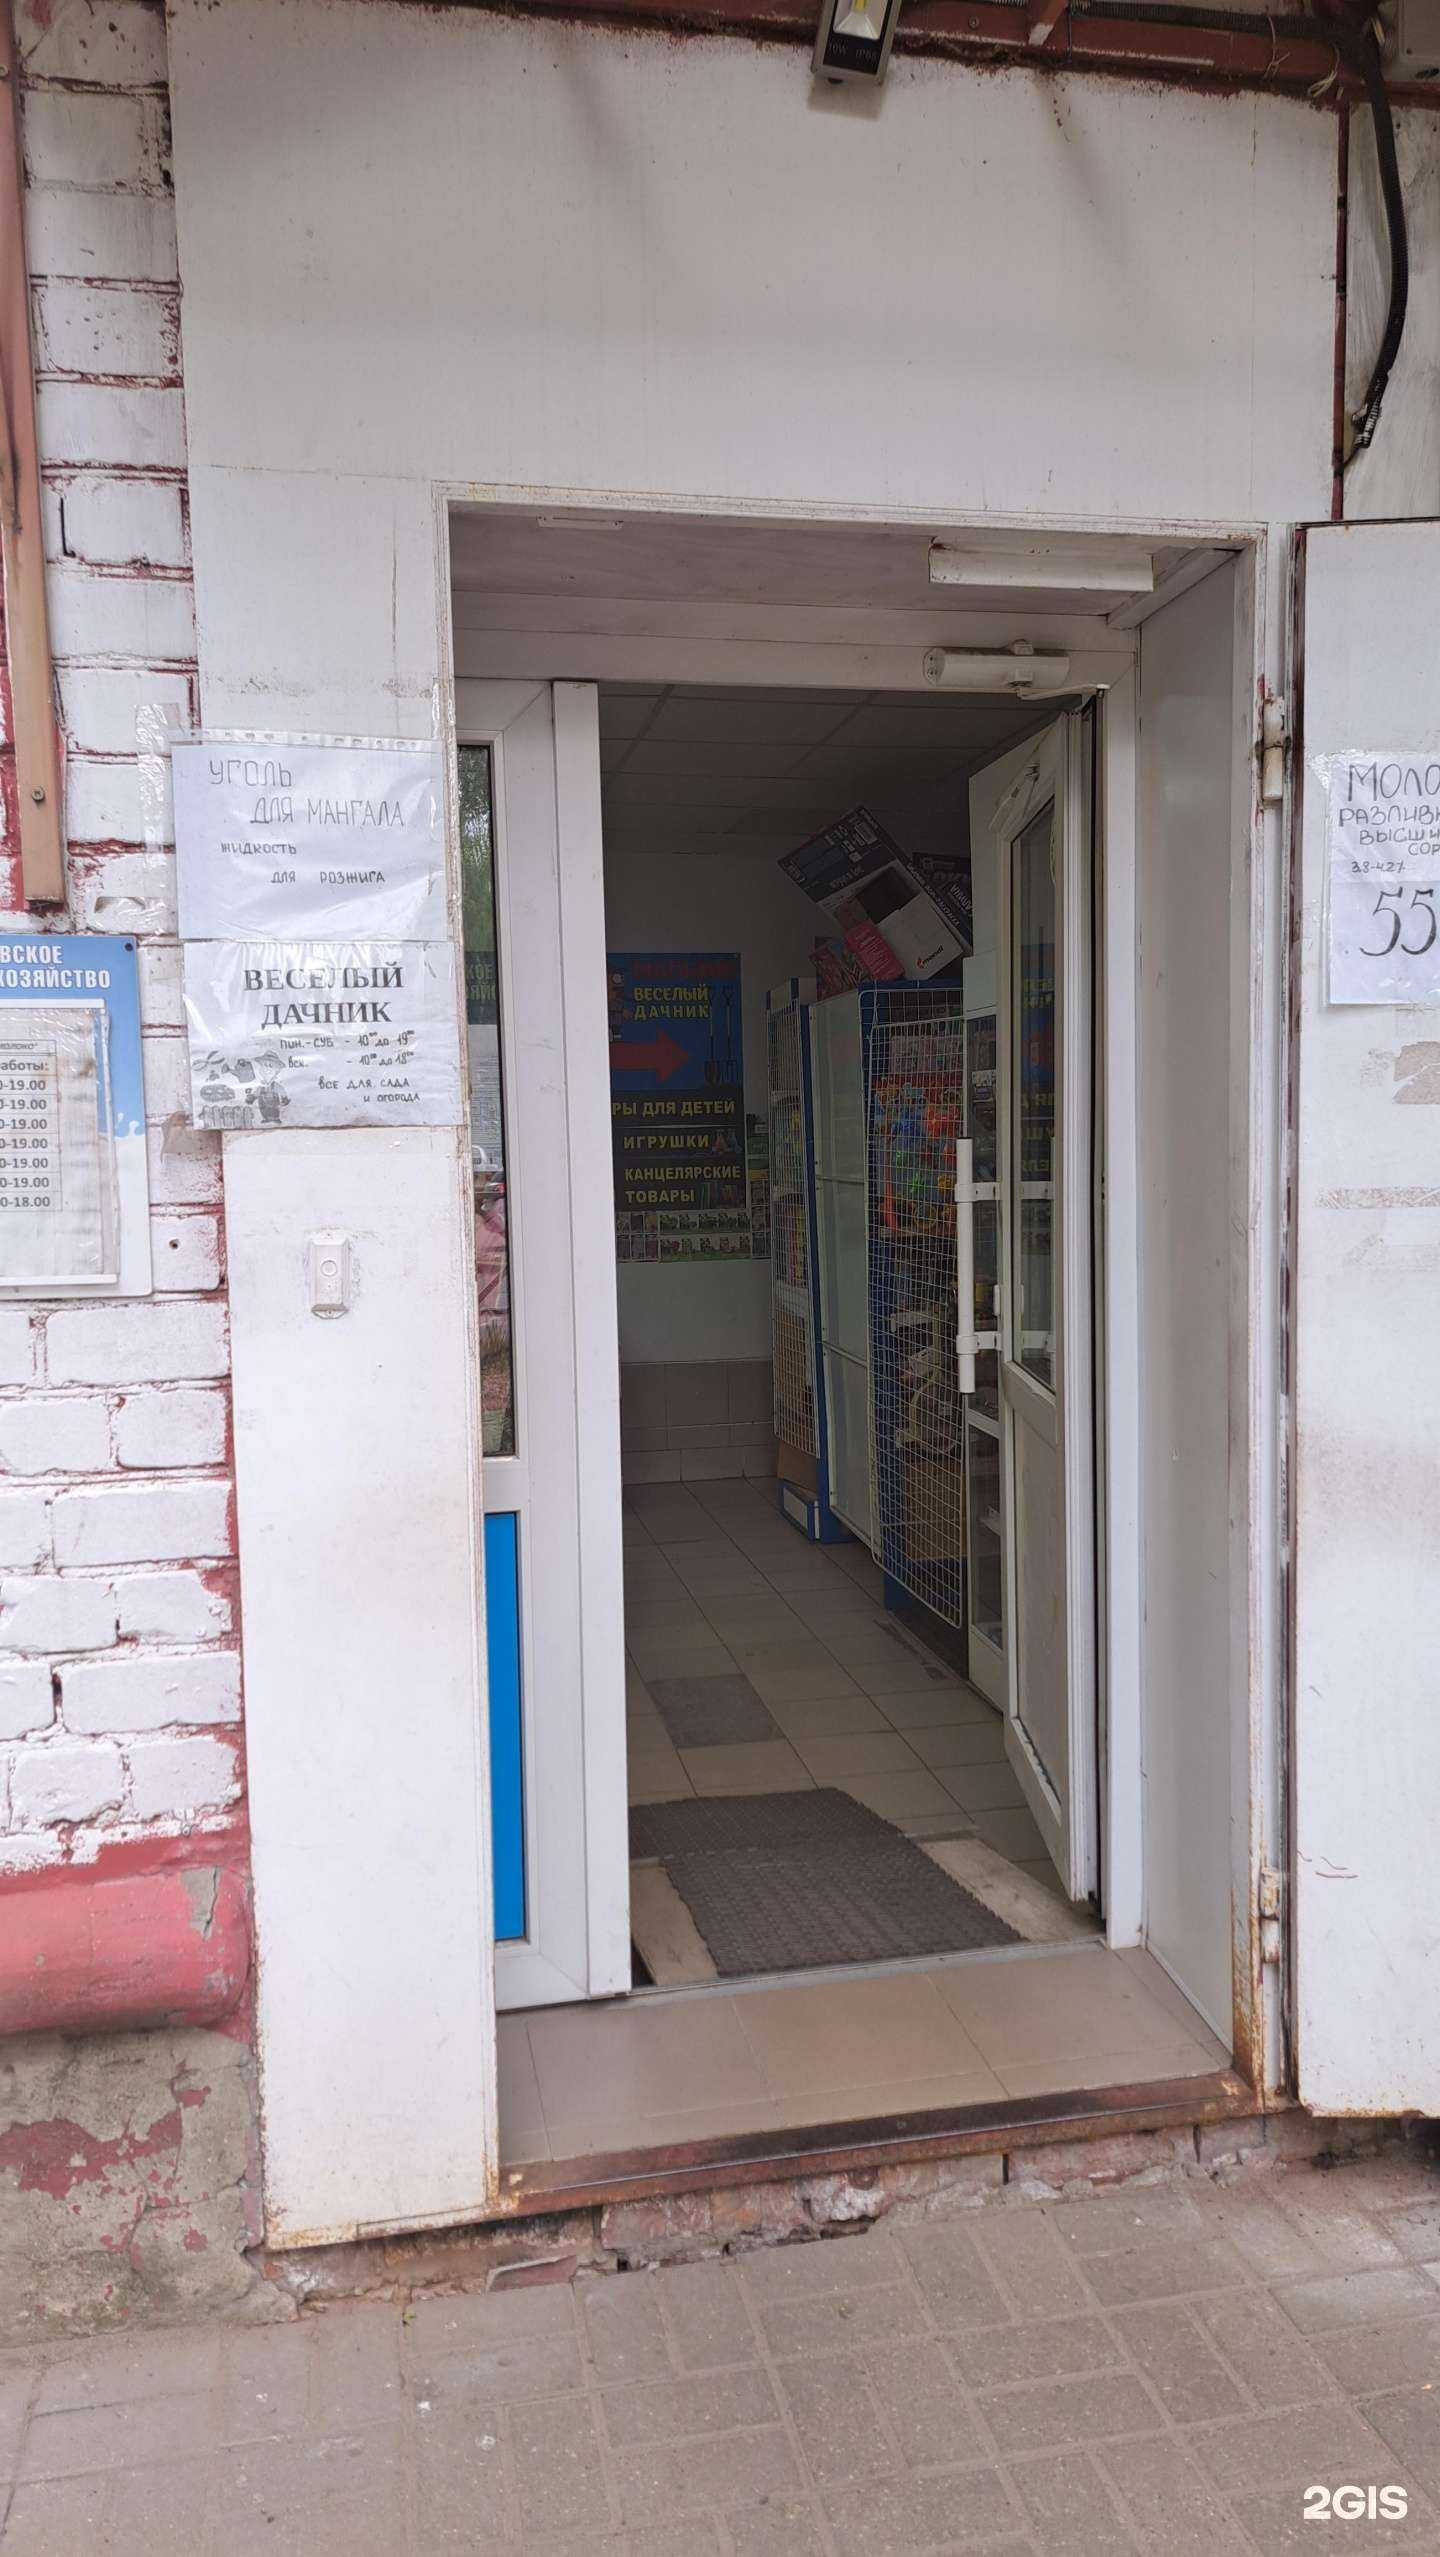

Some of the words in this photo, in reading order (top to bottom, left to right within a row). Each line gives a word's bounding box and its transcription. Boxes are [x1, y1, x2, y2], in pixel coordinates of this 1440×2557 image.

[210, 760, 292, 787] УГОЛЬ
[250, 797, 294, 824] ДЛЯ
[307, 799, 404, 827] МАНГАЛА
[221, 842, 297, 855] ЖИДКОСТЬ
[271, 871, 296, 884] ДЛЯ
[320, 871, 385, 884] РОЗЖИГА
[1359, 886, 1437, 957] 55
[244, 961, 404, 991] ВЕСЕЛЫЙ
[634, 984, 710, 1001] ВЕСЕЛЫЙ
[261, 1001, 393, 1030] ДАЧНИК
[634, 1005, 710, 1021] ДАЧНИК
[380, 1078, 410, 1088] САДА
[377, 1093, 421, 1103] ОГОРОДА
[642, 1102, 676, 1117] ДЛЯ
[681, 1098, 736, 1117] ДЕТЕЙ
[623, 1135, 710, 1150] ИГРУШКИ
[625, 1165, 741, 1182] КАНЦЕЛЯРСКИЕ
[0, 1197, 50, 1207] 0-18.00
[625, 1189, 695, 1204] ТОВАРЫ
